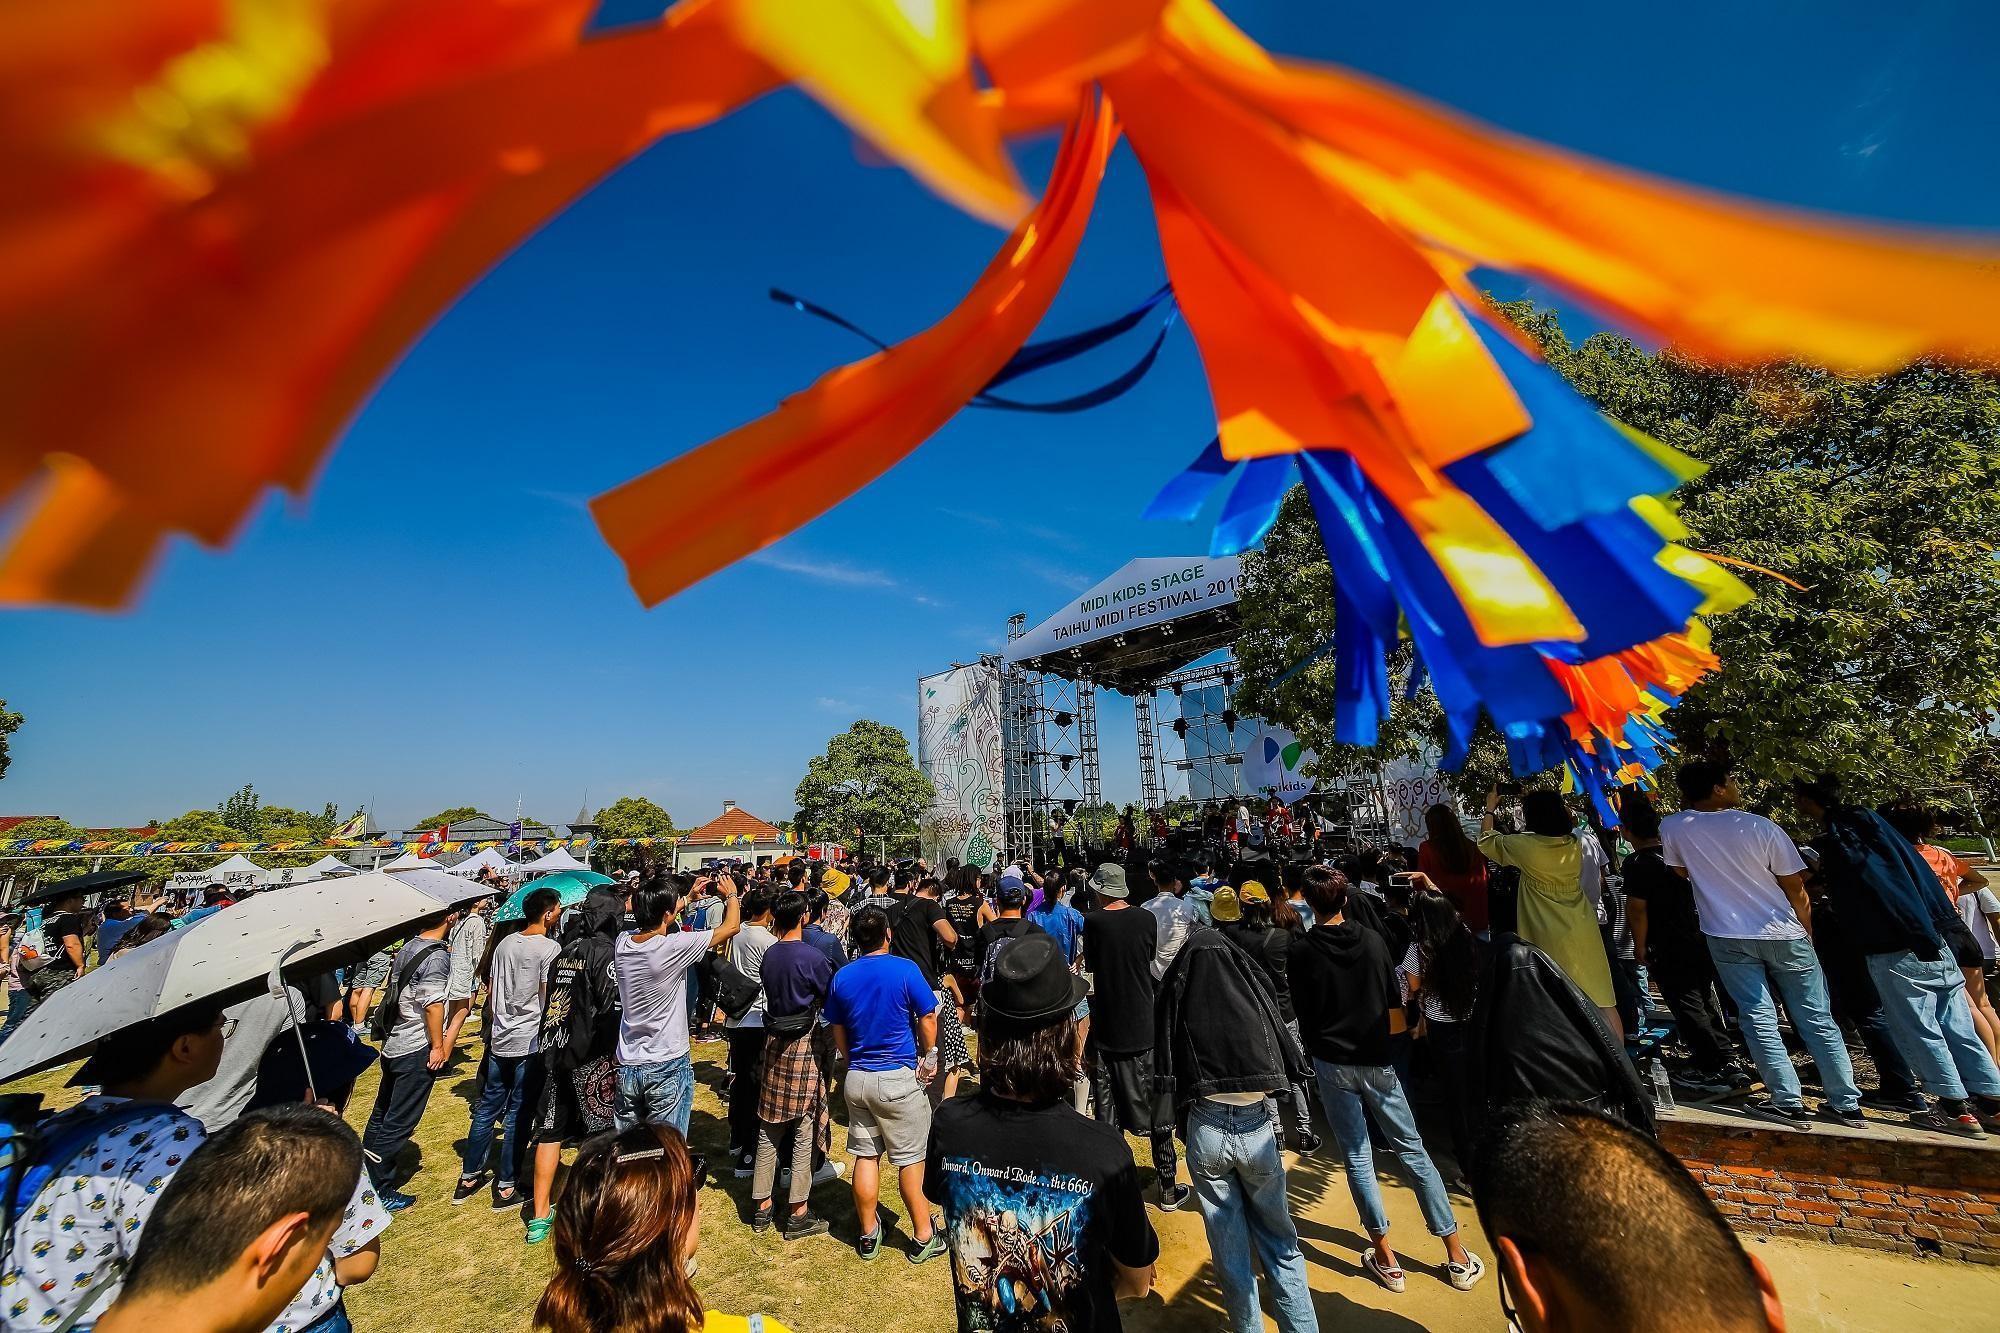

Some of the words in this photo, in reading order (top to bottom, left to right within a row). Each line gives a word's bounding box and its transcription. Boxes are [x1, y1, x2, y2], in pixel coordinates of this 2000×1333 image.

[1080, 594, 1108, 614] MIDI
[1113, 581, 1147, 605] KIDS
[1151, 564, 1205, 592] STAGE
[1053, 619, 1091, 641] TAIHU
[1095, 610, 1124, 629] MIDI
[1129, 588, 1202, 619] FESTIVAL
[972, 1161, 1010, 1180] Onward
[1067, 1177, 1094, 1196] 666!
